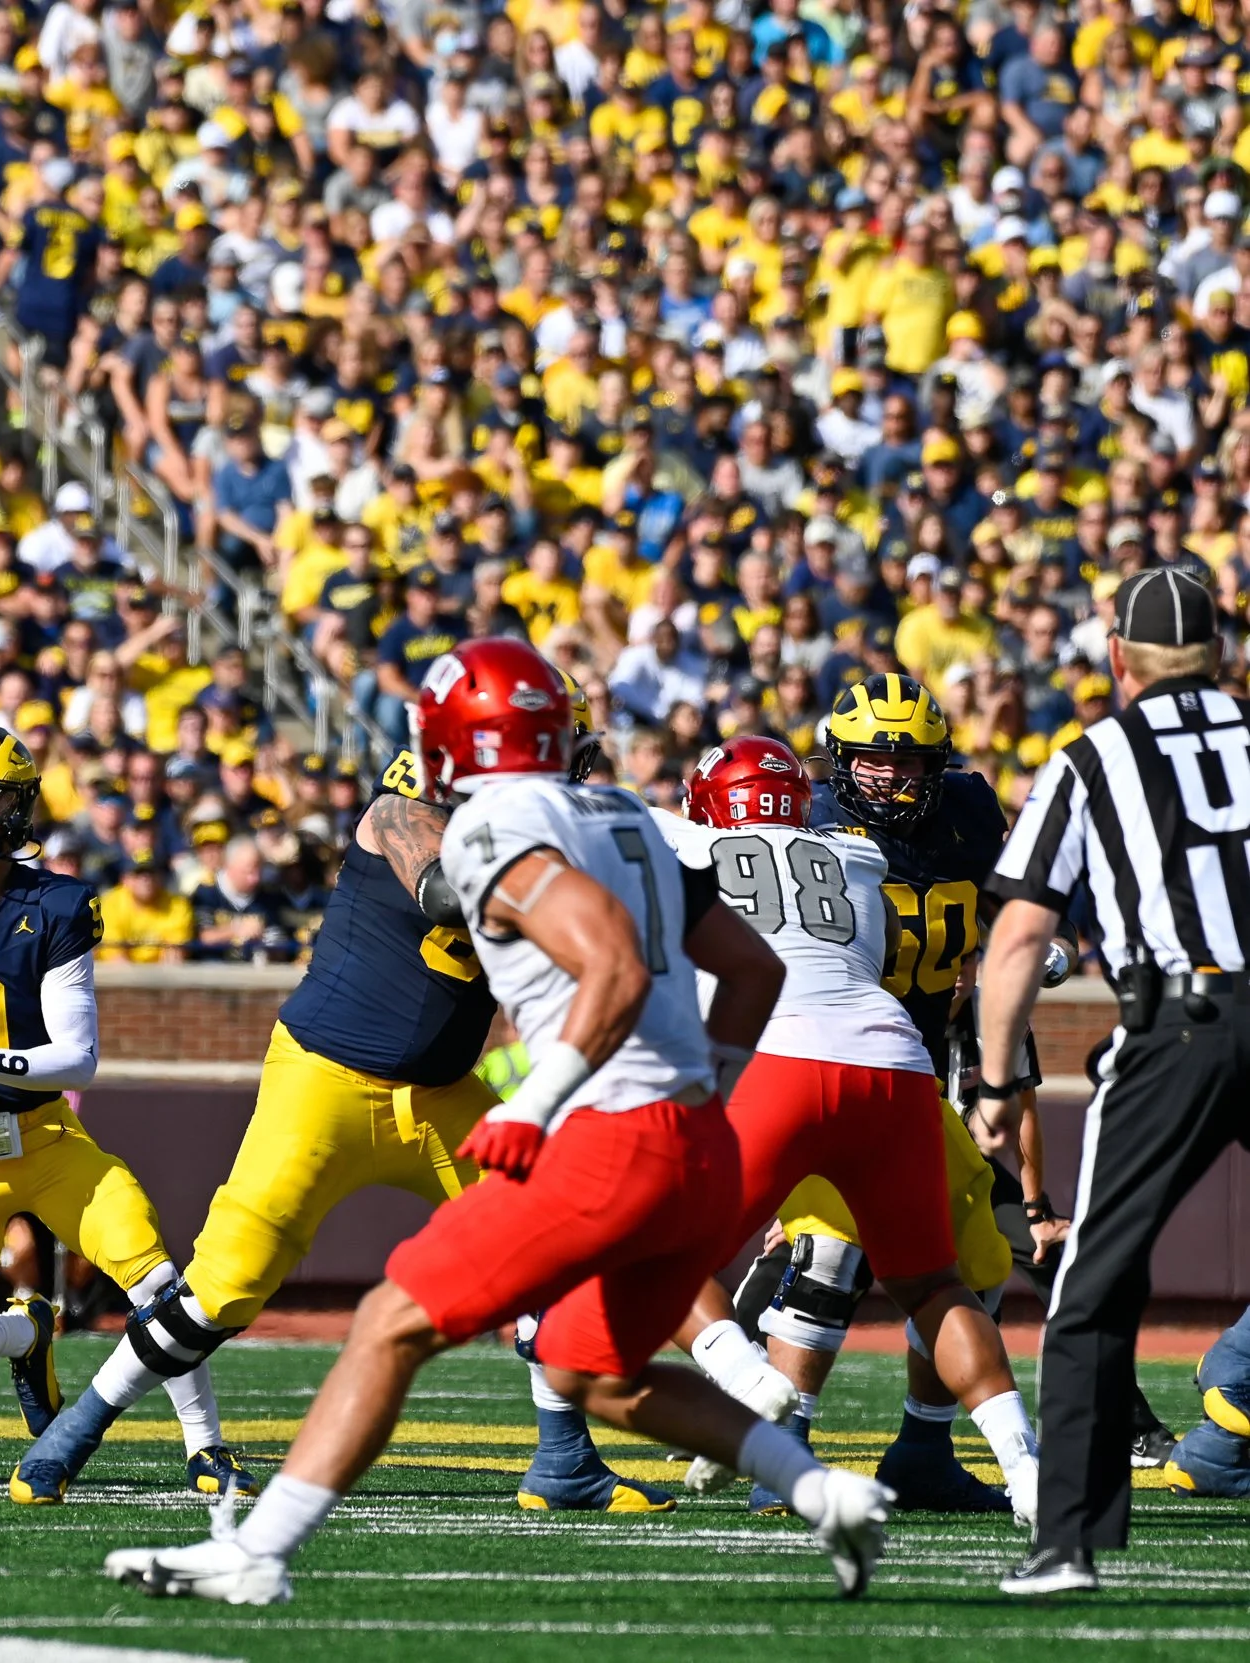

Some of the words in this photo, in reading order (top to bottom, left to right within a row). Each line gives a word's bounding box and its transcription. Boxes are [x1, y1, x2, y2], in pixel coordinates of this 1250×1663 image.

[537, 733, 549, 761] 7
[887, 732, 900, 741] M
[1155, 726, 1250, 833] U
[760, 793, 791, 816] 98
[463, 822, 496, 864] 7
[611, 827, 668, 974] 7
[709, 834, 856, 946] 98
